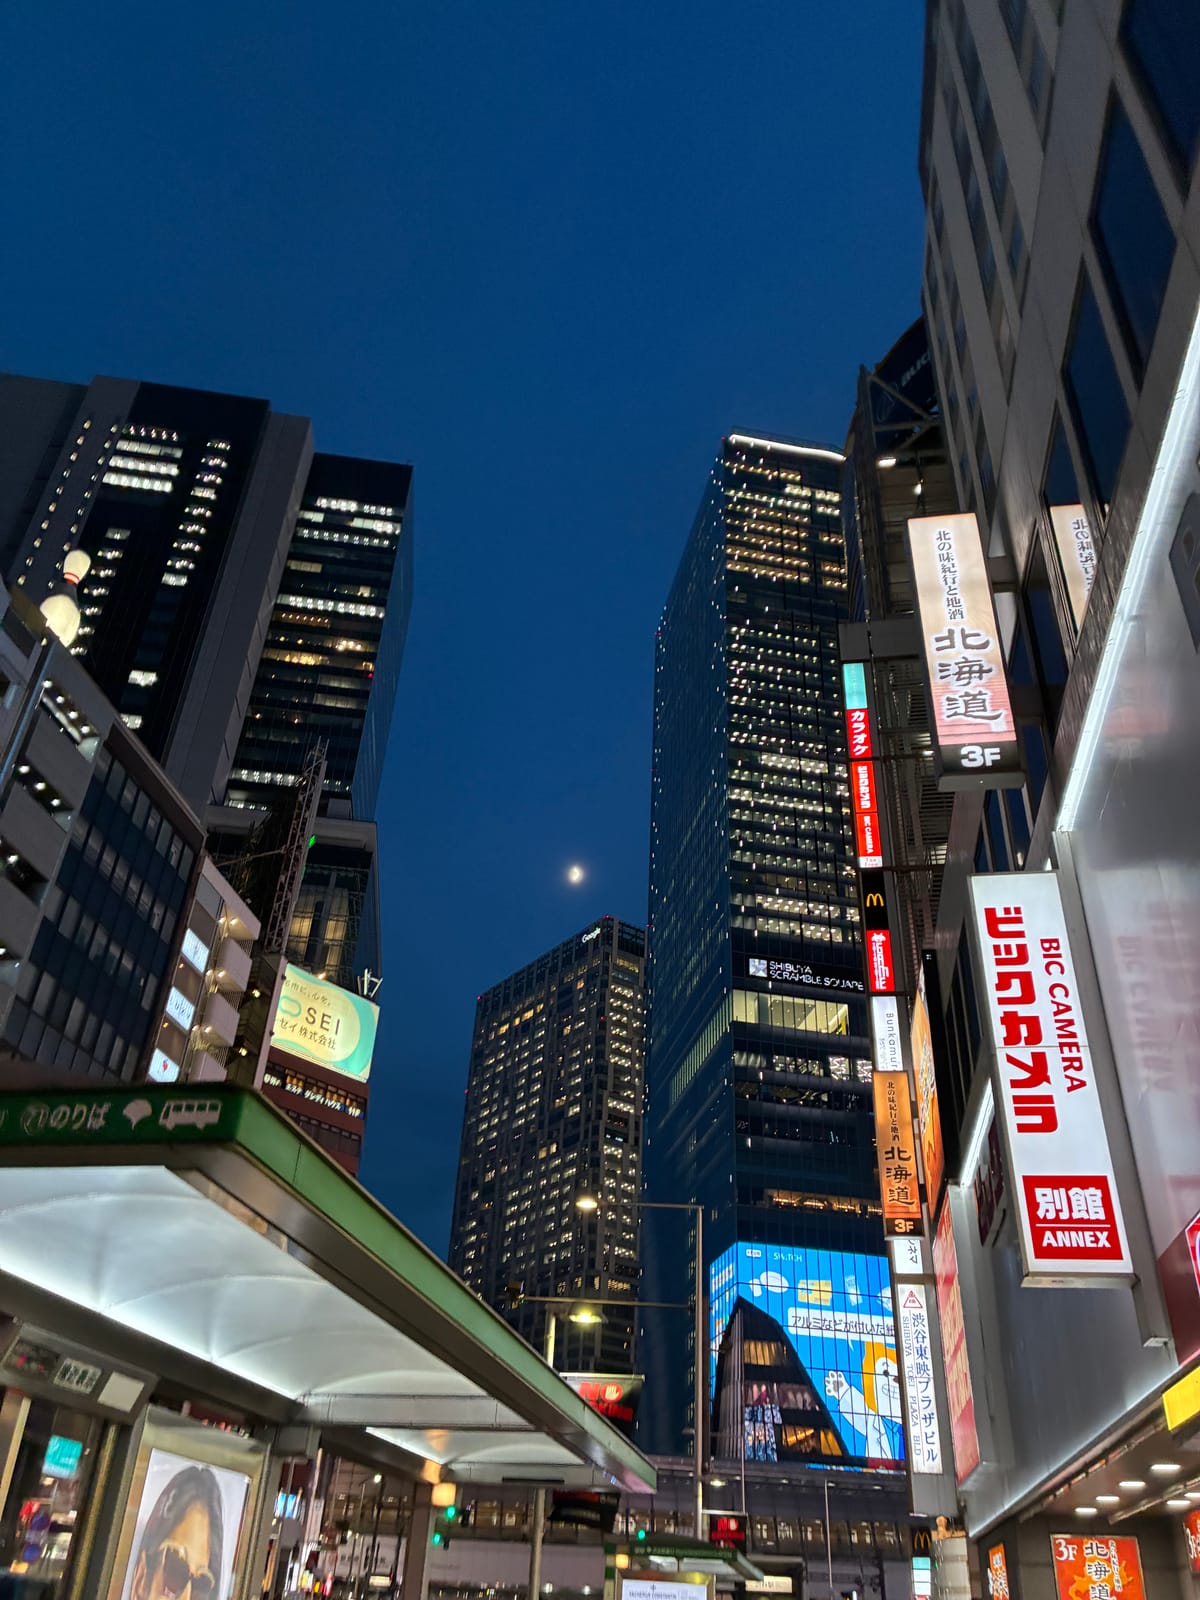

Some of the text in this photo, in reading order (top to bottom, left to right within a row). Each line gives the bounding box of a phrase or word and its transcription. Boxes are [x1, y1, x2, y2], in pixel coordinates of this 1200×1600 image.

[936, 530, 964, 620] 北の味紀行と地酒
[934, 628, 1003, 721] 北海道
[851, 710, 868, 756] カラオケ
[960, 745, 1001, 767] 3F
[865, 827, 874, 854] CAMERA
[769, 960, 813, 974] SHIBUYA
[769, 970, 865, 991] SCRAMBLE SQUARE
[984, 906, 1059, 1134] ビックカメラ
[1039, 937, 1088, 1093] BIC CAMERA
[885, 1013, 898, 1071] Bunkamur
[884, 1146, 915, 1206] 北海道
[894, 1219, 915, 1233] 3F
[1033, 1186, 1106, 1221] 別館
[1041, 1230, 1112, 1249] ANNEX
[902, 1315, 913, 1357] SHIBUYA
[909, 1395, 919, 1428] PLAZA
[911, 1313, 938, 1463] 渋谷東映プラザビル
[1055, 1538, 1078, 1561] 3F
